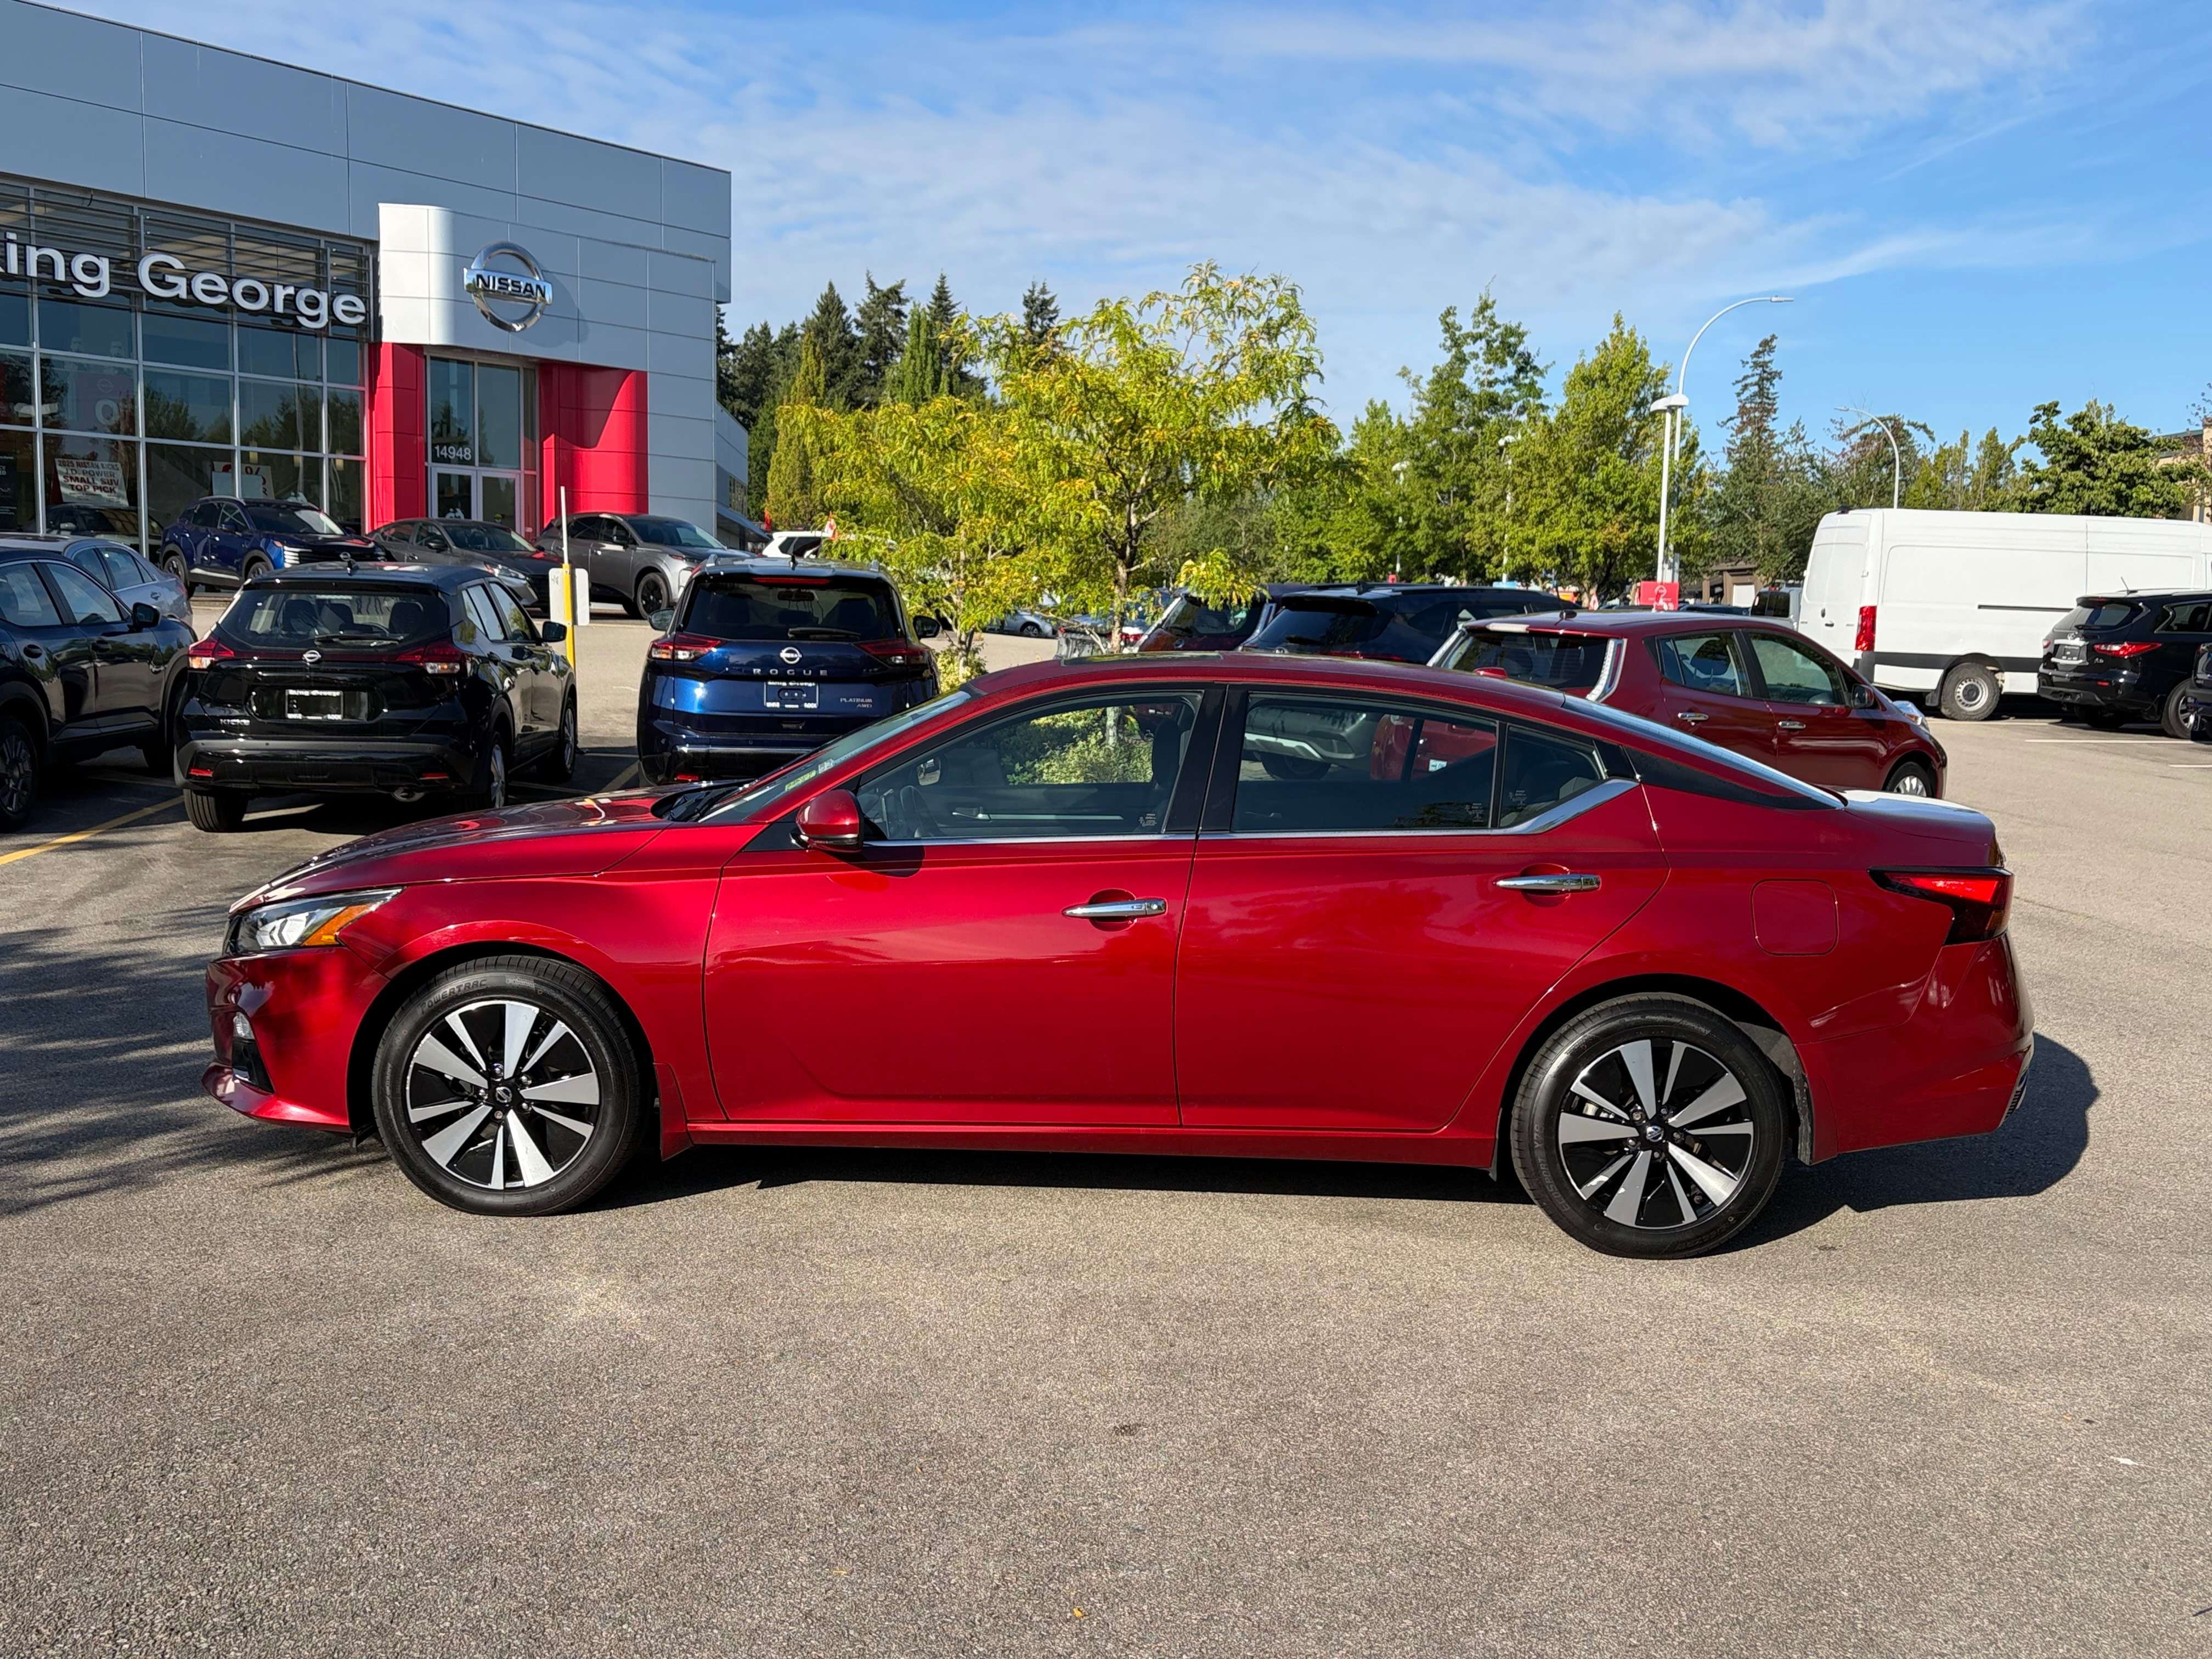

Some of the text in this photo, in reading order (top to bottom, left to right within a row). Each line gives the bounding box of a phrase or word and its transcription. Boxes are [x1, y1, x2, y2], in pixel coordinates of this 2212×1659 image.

[0, 232, 366, 329] ing George
[476, 274, 546, 298] NISSAN
[435, 445, 472, 461] 14948
[63, 475, 119, 486] SMALL SUV
[82, 469, 115, 478] POWER
[420, 979, 487, 1014] POWERTRAC
[1537, 1155, 1571, 1211] ECOSPORT
